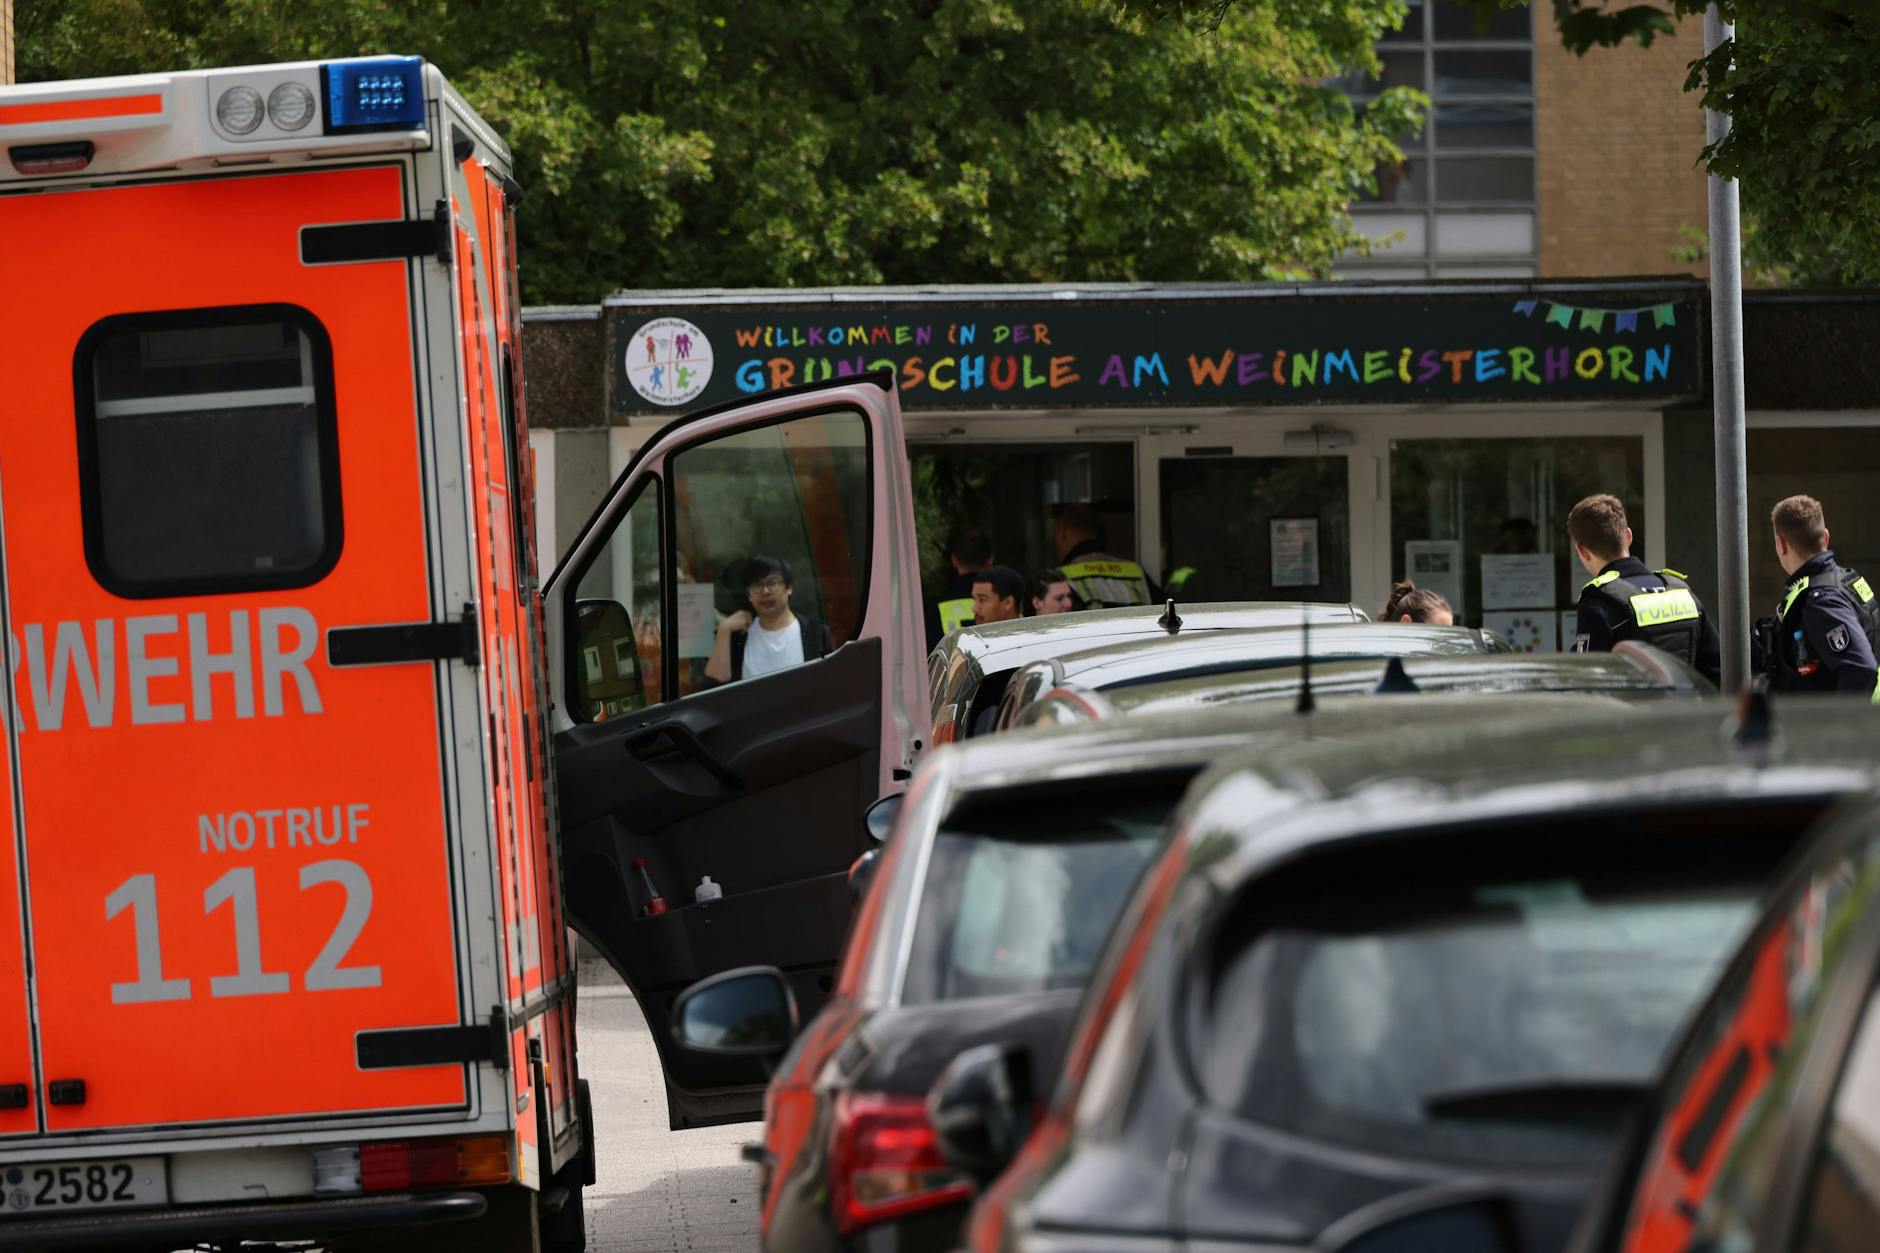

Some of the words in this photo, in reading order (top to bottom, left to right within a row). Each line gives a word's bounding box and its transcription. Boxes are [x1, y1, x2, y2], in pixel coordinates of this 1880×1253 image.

[993, 322, 1052, 346] DER
[1099, 350, 1170, 388] AM
[198, 803, 370, 853] NOTRUF
[105, 859, 382, 1004] 112
[33, 1163, 135, 1206] 2582
